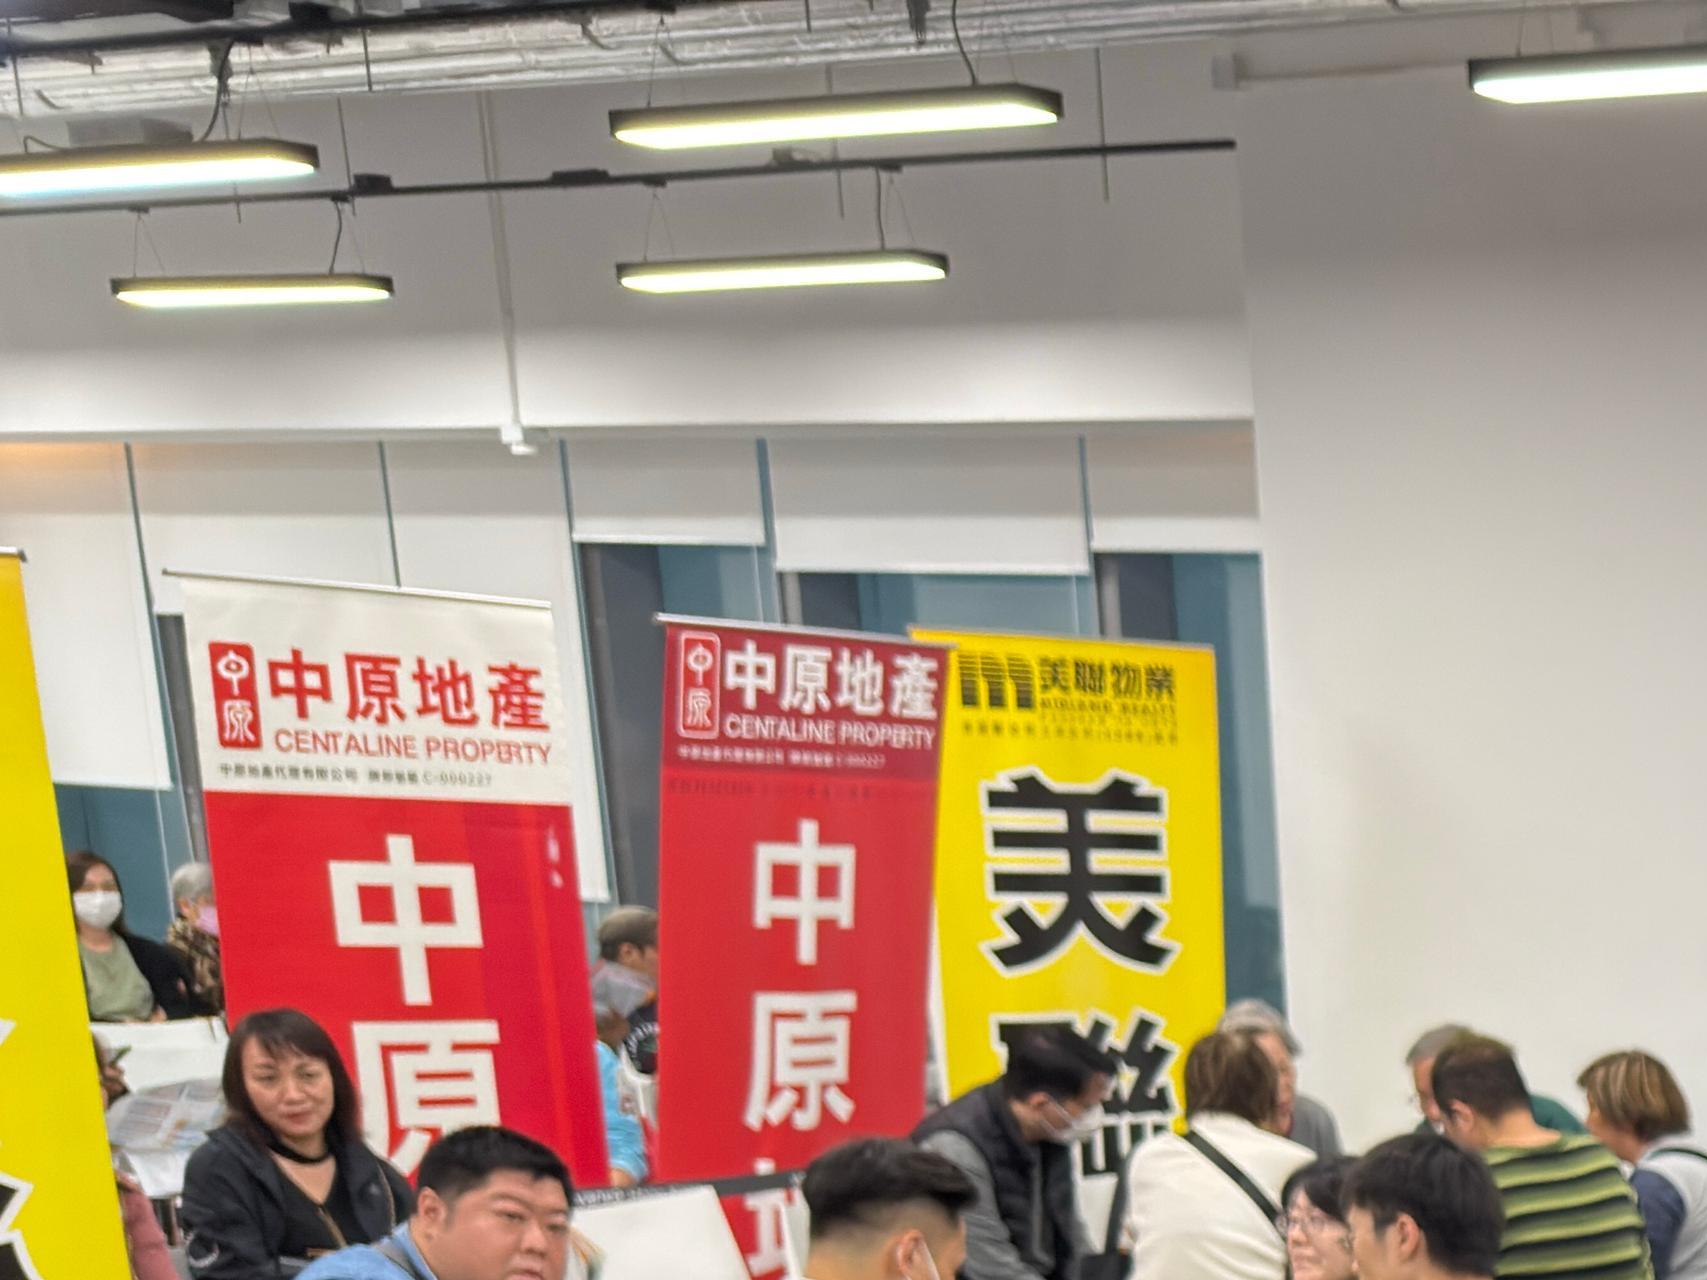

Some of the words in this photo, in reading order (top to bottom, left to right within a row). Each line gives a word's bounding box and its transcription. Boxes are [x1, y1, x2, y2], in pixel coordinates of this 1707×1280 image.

[267, 647, 551, 732] 中原地產
[722, 639, 939, 720] 中原地產
[1039, 655, 1175, 700] 美聯物業
[275, 727, 417, 760] CENTALINE
[425, 735, 552, 765] PROPERTY
[724, 712, 835, 745] CENTALINE
[840, 723, 937, 750] PROPERTY
